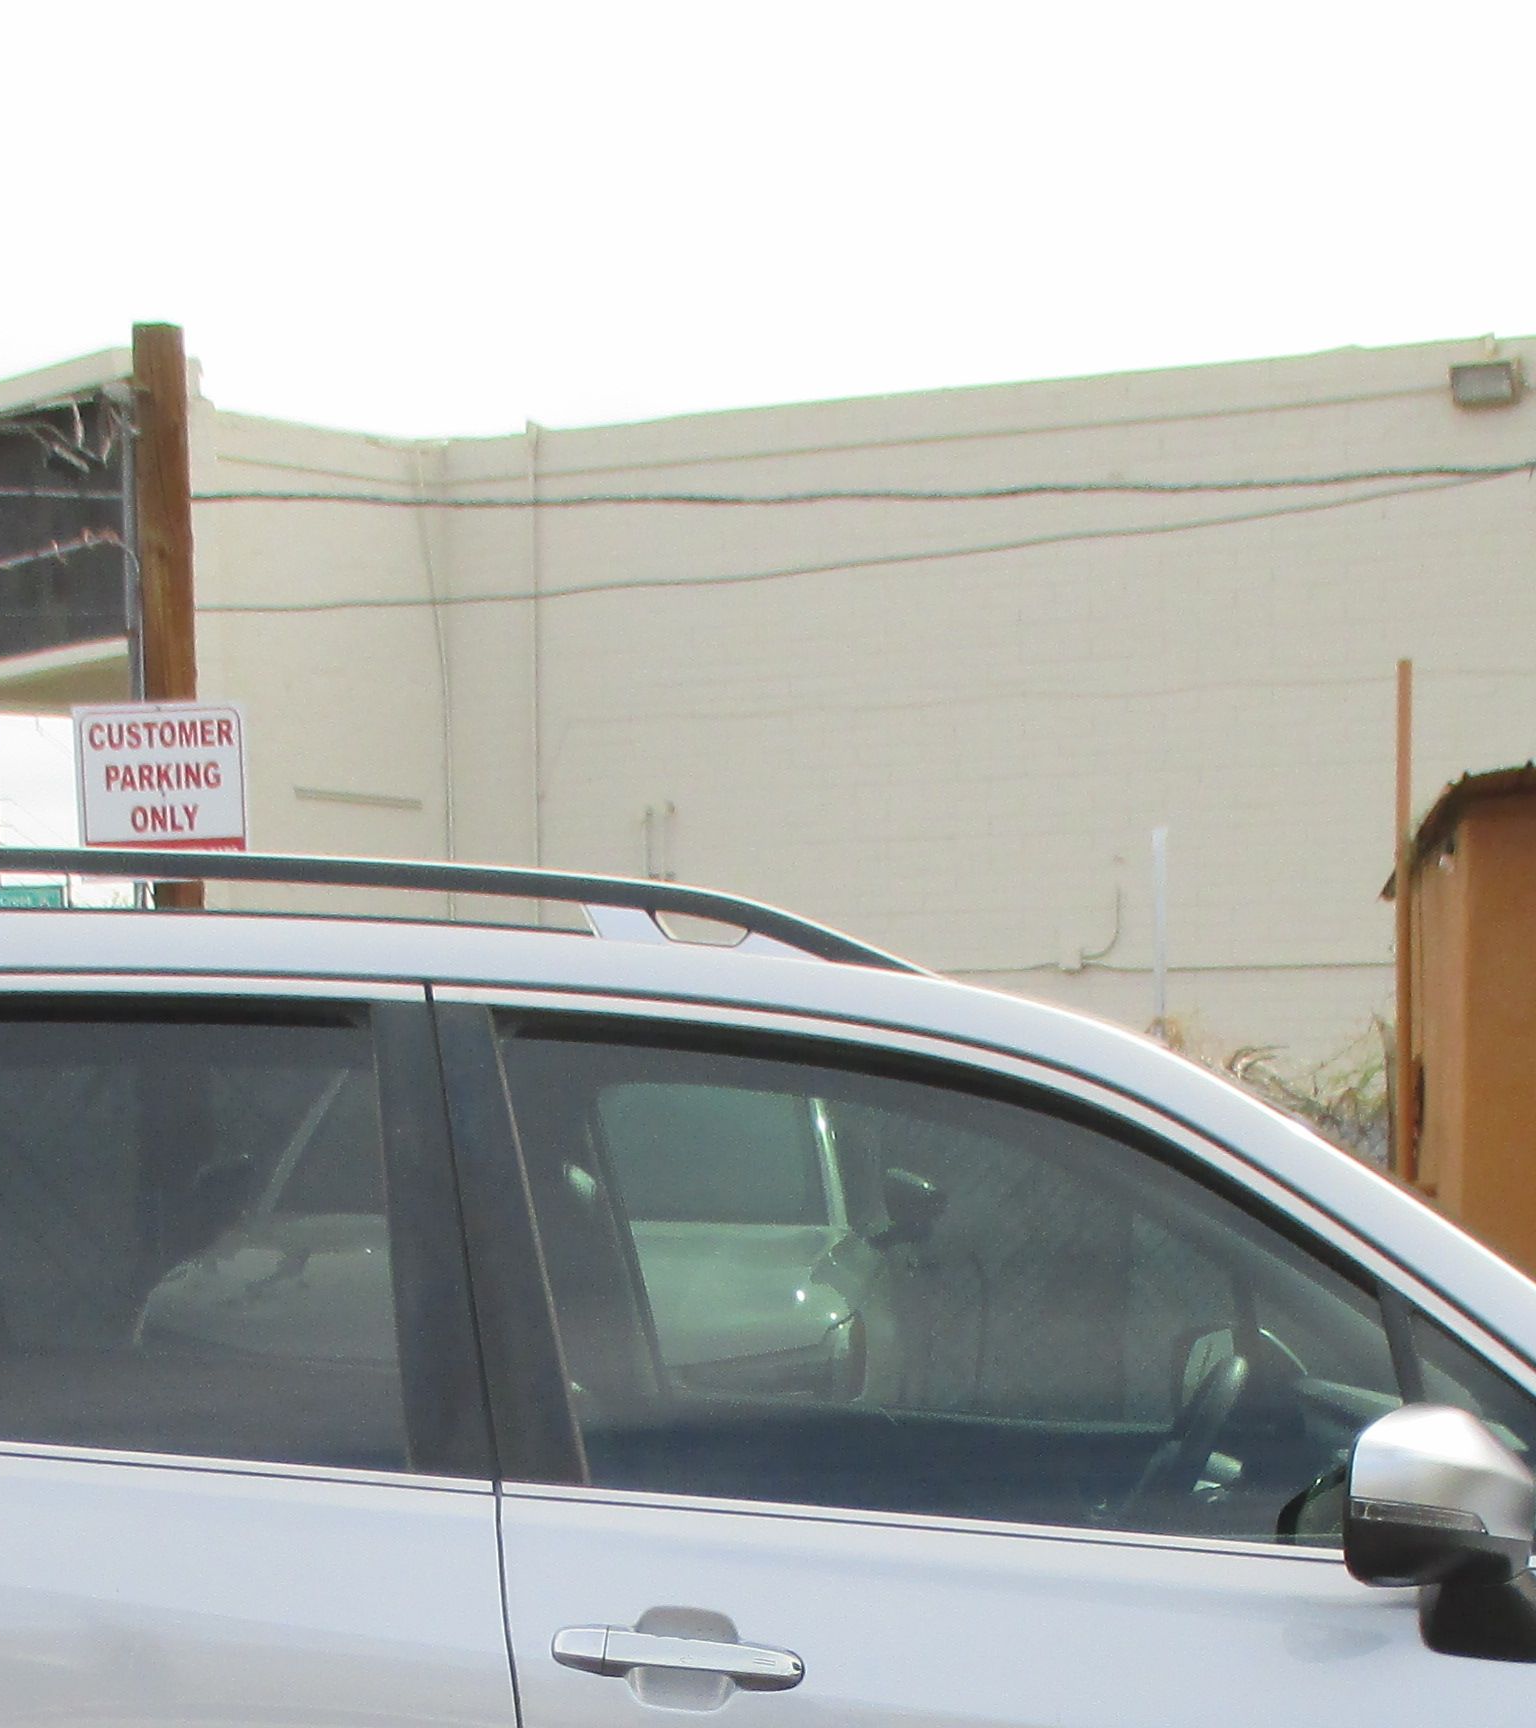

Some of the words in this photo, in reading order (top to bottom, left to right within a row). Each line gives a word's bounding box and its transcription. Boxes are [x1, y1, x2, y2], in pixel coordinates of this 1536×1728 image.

[88, 719, 234, 751] CUSTOMER
[105, 761, 222, 792] PARKING
[130, 803, 199, 833] ONLY
